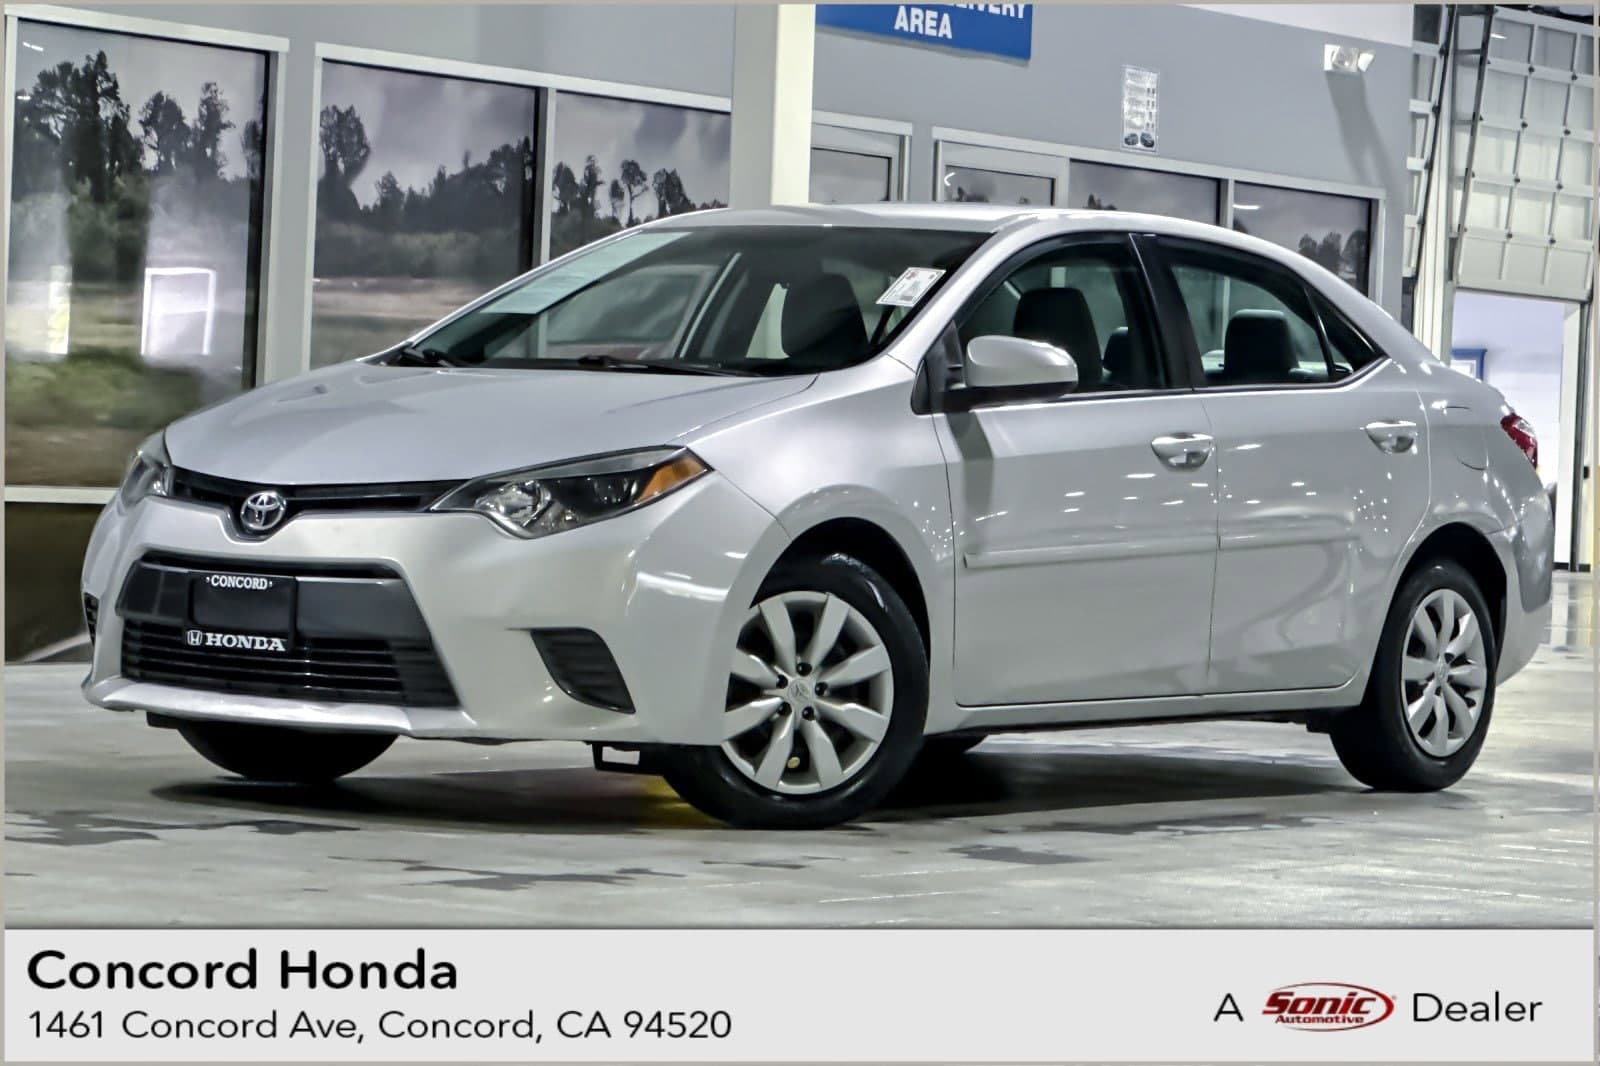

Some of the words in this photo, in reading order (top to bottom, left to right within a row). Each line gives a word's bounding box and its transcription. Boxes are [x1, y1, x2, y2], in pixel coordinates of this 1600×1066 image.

[894, 5, 953, 39] AREA
[211, 574, 268, 590] CONCORD
[205, 632, 286, 652] HONDA
